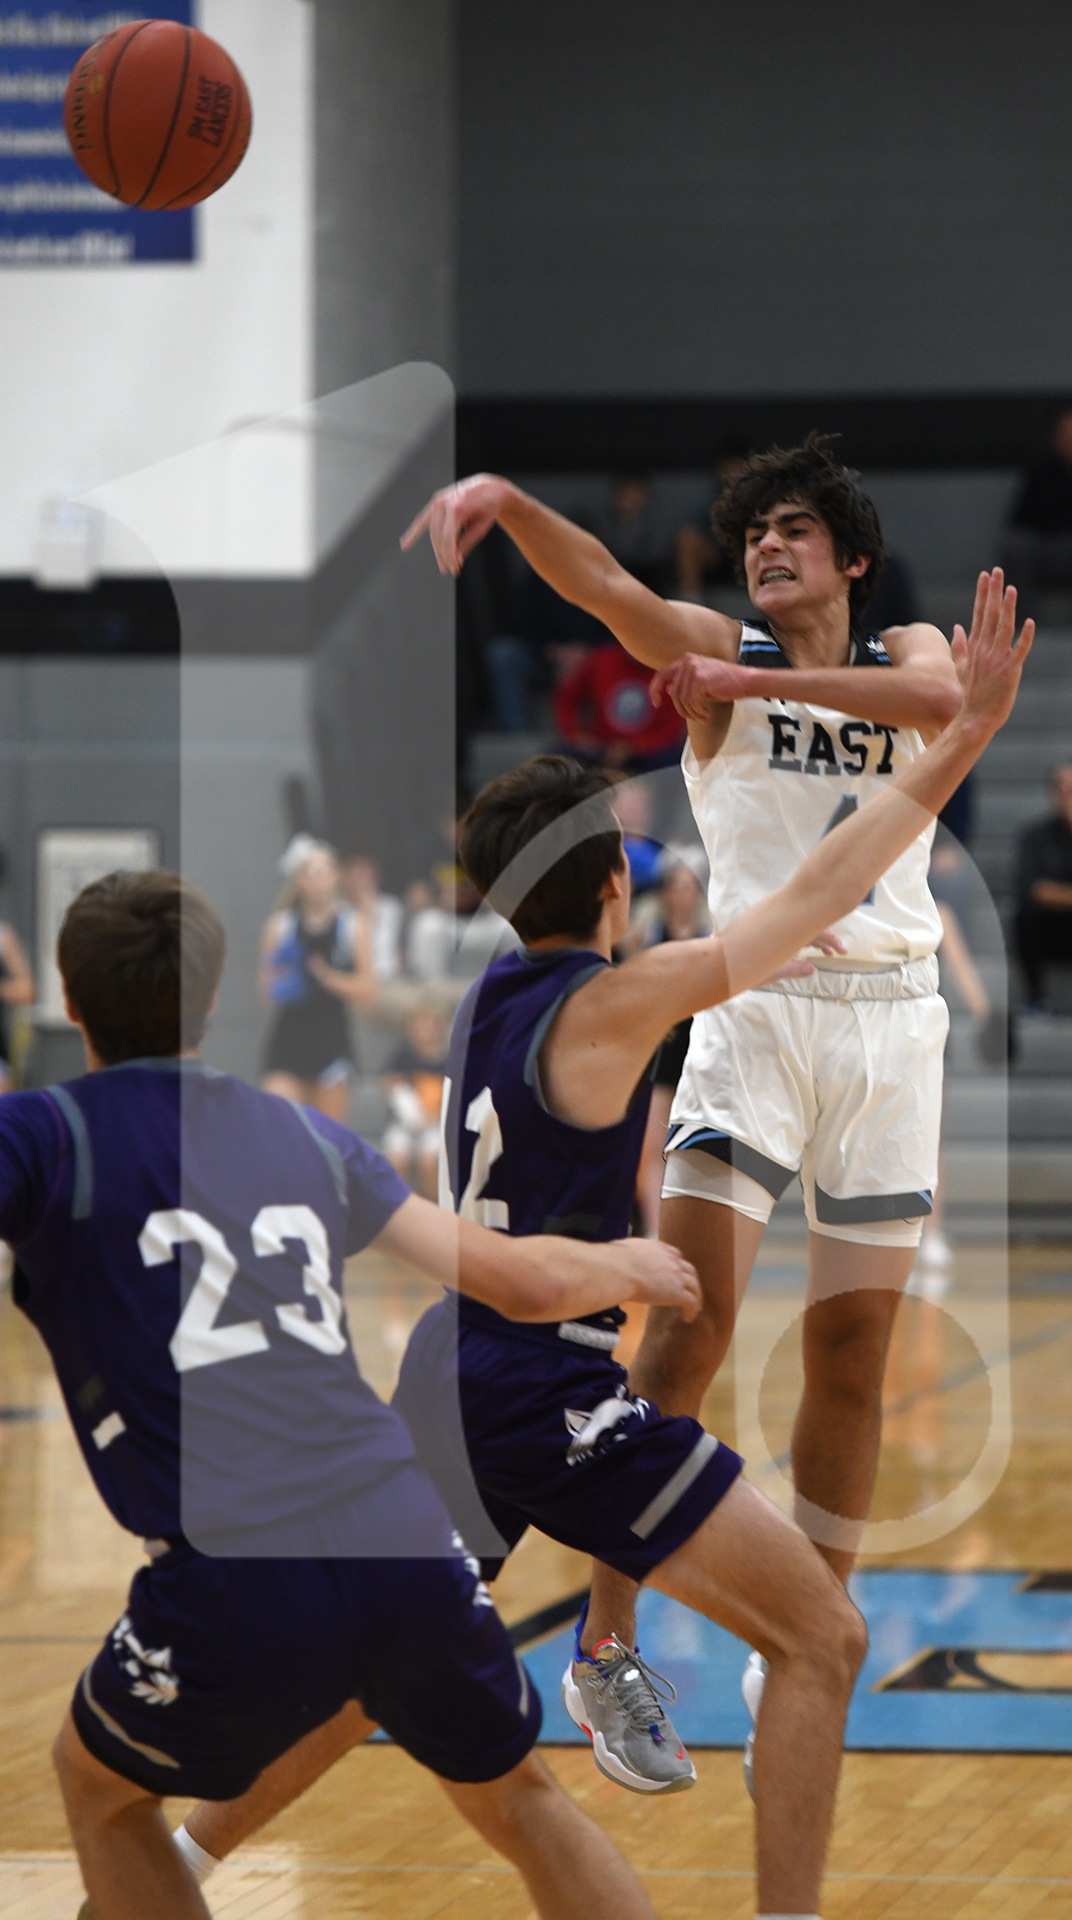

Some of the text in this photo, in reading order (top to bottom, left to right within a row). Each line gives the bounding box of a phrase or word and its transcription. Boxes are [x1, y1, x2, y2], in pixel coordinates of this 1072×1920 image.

[201, 84, 232, 148] LANCERS
[767, 713, 899, 776] EAST
[137, 1205, 347, 1373] 23
